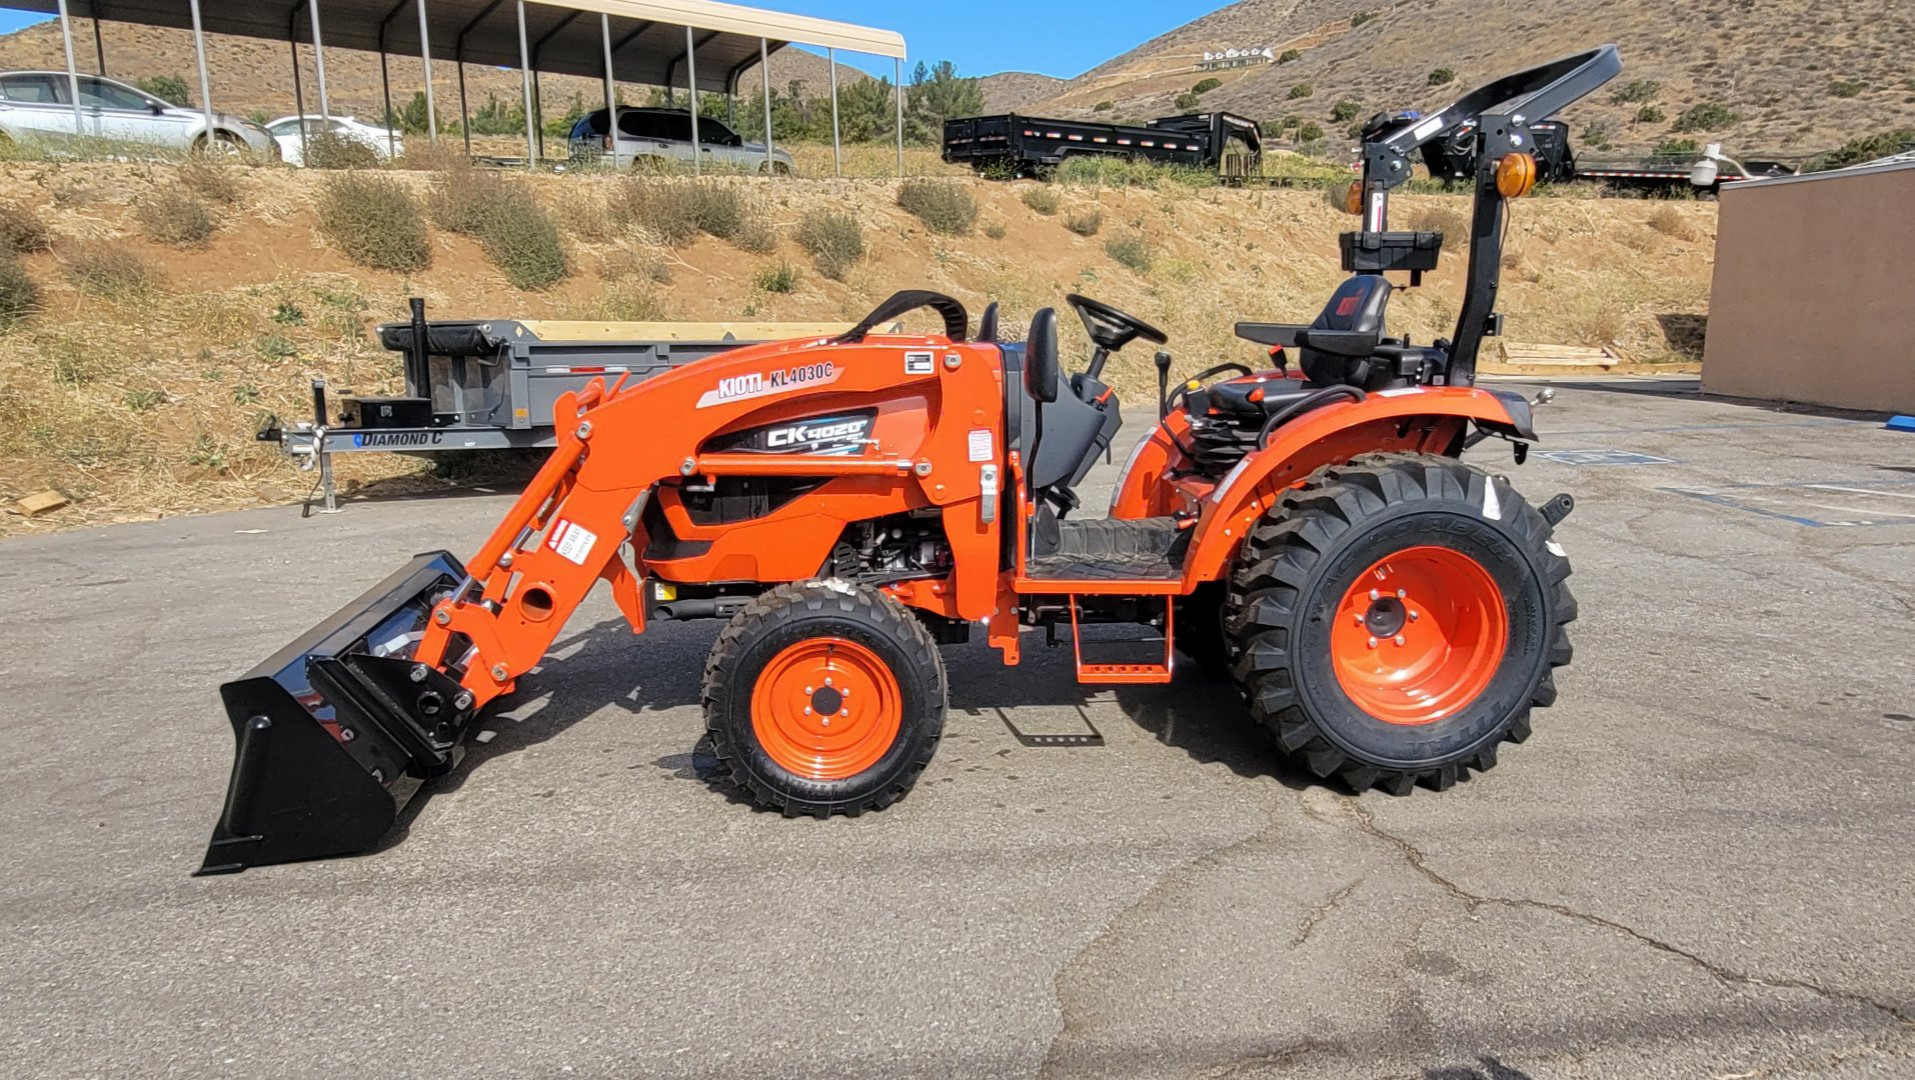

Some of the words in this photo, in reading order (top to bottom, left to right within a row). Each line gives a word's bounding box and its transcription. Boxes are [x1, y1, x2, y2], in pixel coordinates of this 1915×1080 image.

[718, 373, 763, 399] KIOTI
[770, 362, 833, 388] KL4030C
[431, 431, 443, 444] C
